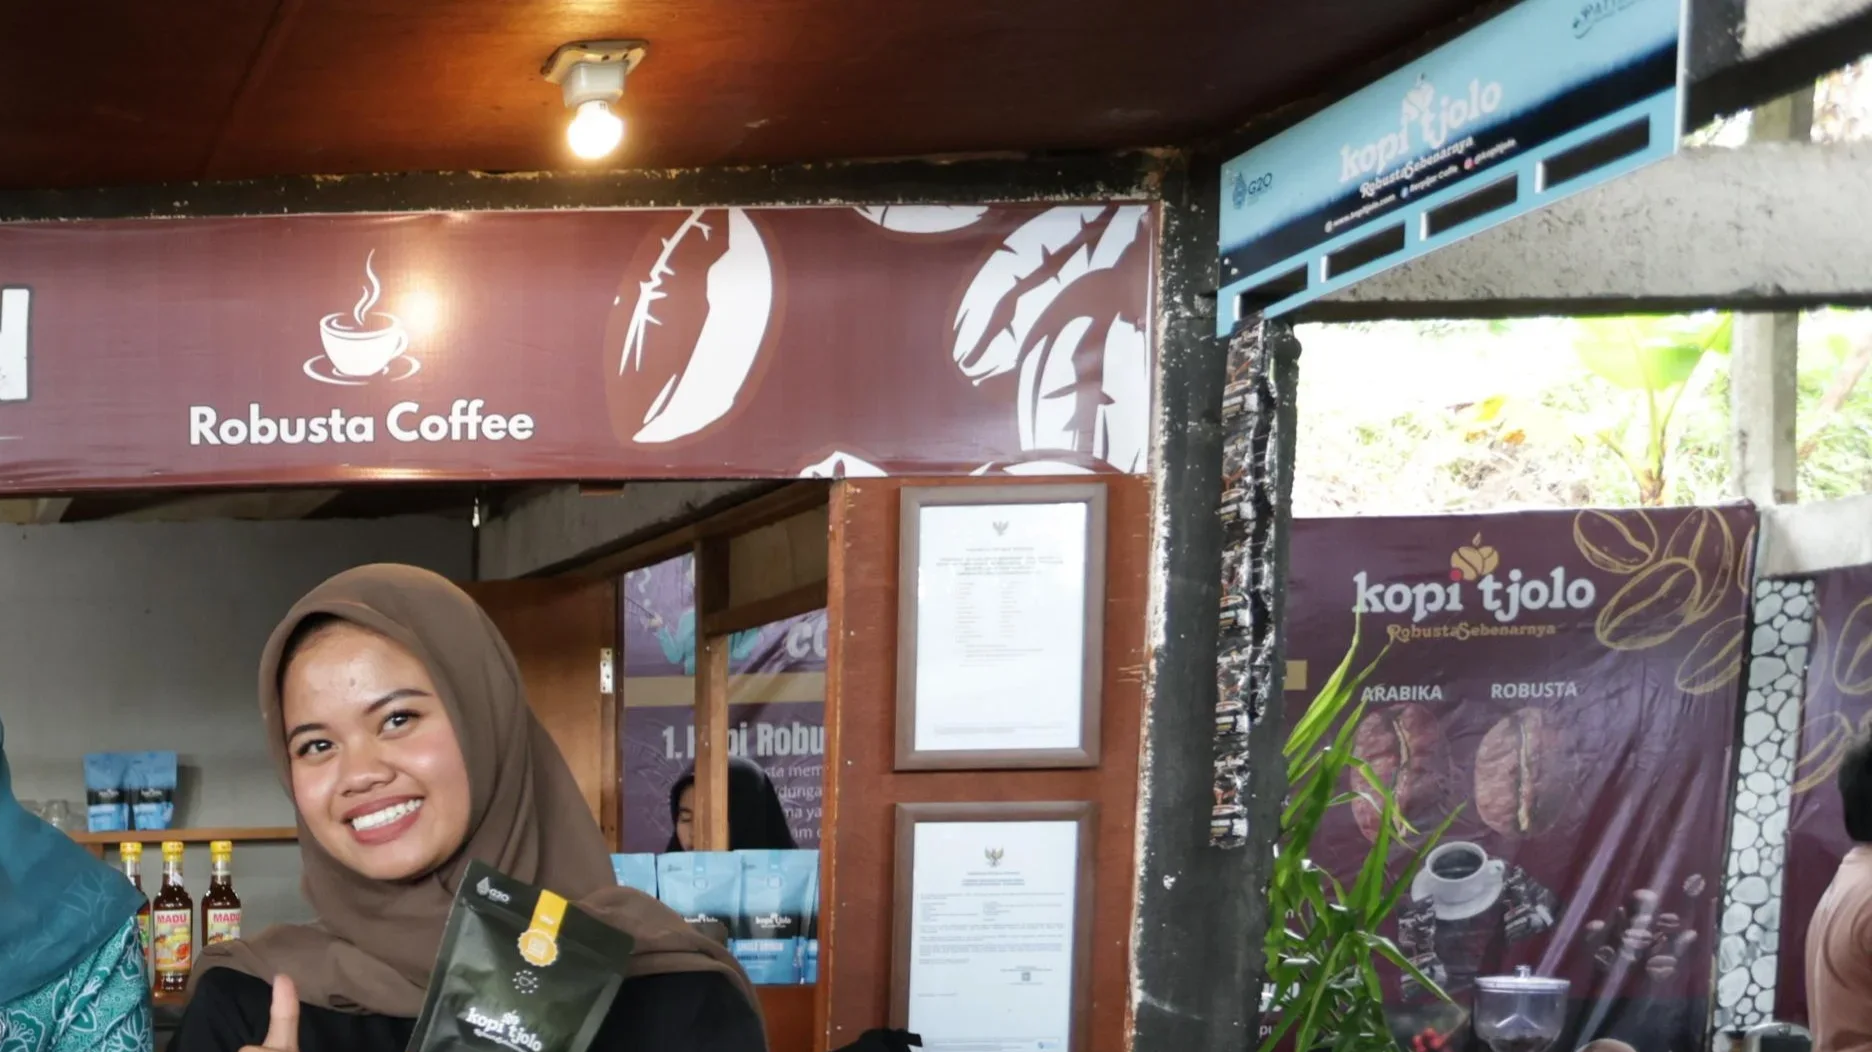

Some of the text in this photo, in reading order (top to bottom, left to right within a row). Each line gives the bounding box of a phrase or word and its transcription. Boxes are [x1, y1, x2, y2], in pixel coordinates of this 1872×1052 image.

[1340, 132, 1409, 183] kopi
[1423, 79, 1501, 149] tjolo
[1249, 172, 1272, 195] G20
[189, 399, 534, 445] Robusta Coffee
[1352, 566, 1595, 622] kopi tjolo
[1361, 681, 1577, 702] ARABIKA ROBUSTA
[662, 725, 682, 760] 1.
[156, 914, 187, 924] MADU
[465, 1007, 504, 1034] kopi
[508, 1025, 542, 1052] tjolo
